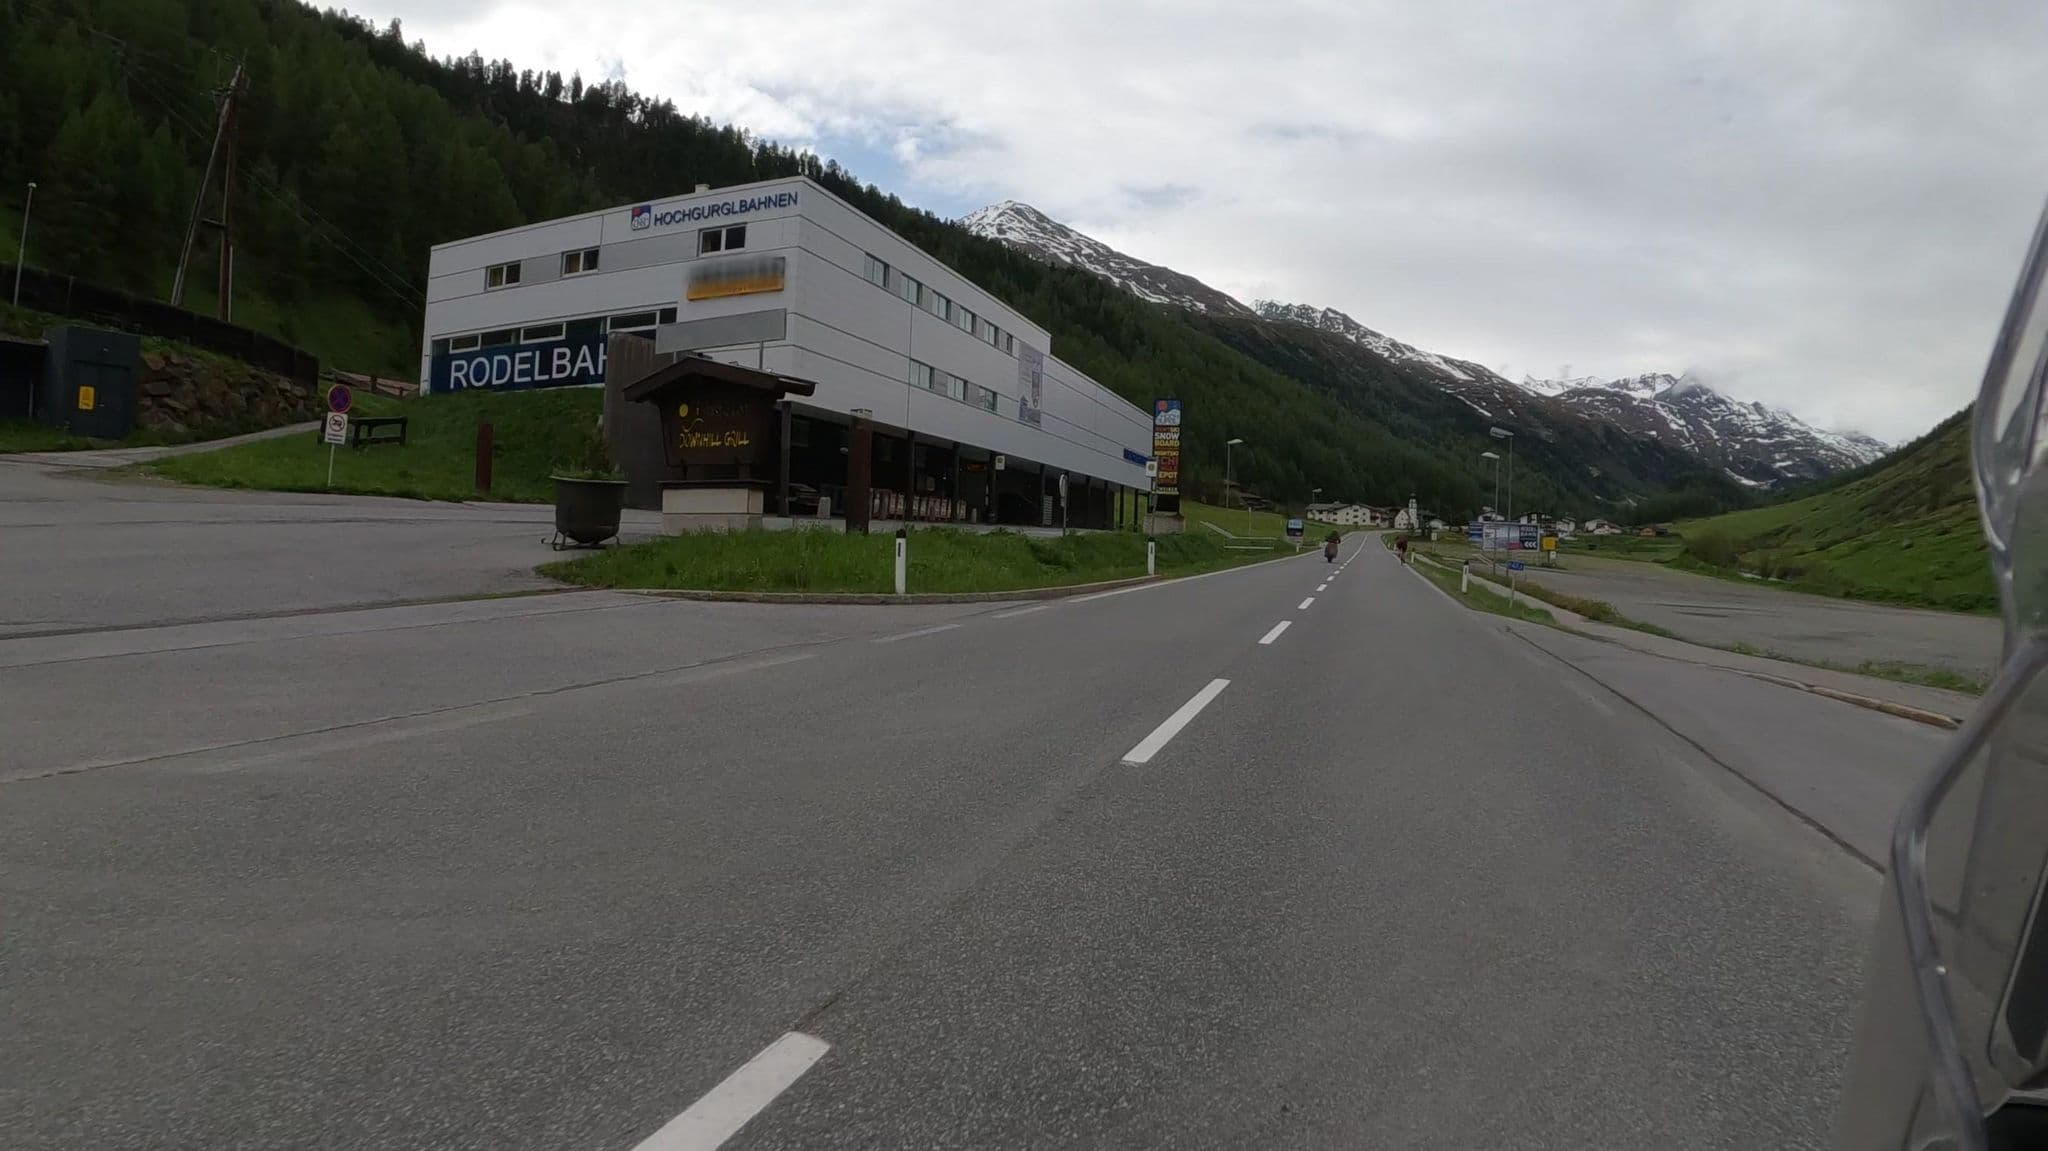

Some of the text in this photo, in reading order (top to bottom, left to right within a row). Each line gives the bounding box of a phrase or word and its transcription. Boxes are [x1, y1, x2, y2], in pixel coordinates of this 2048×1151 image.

[654, 192, 798, 226] HOCHGURGLBAHNEN
[680, 430, 749, 448] DOWNHILL GRILL
[1154, 432, 1180, 440] SNOW
[1154, 439, 1180, 447] BOARD
[1158, 471, 1178, 479] EPOT
